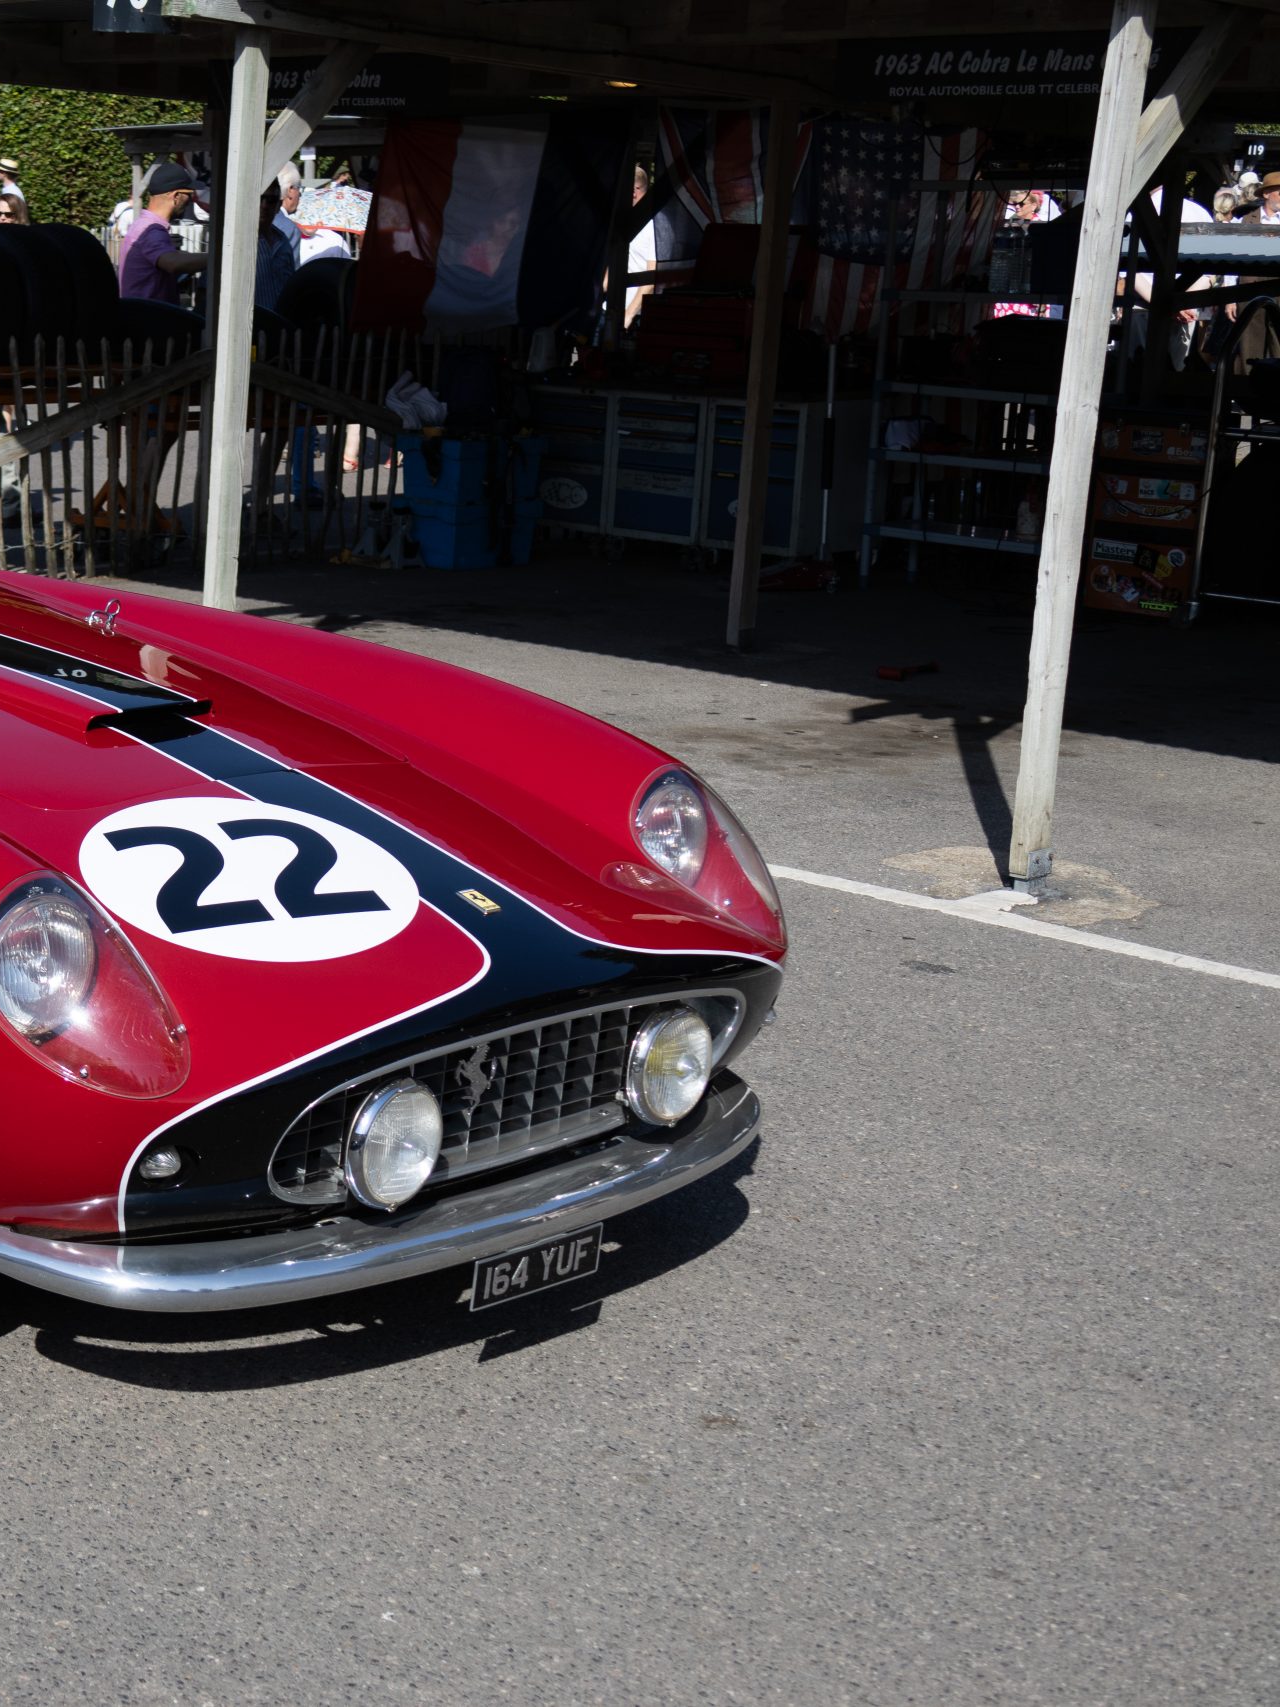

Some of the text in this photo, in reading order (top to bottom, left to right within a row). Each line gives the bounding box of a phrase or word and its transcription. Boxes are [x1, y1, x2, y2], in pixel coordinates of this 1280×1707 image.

[874, 53, 922, 76] 1963
[924, 51, 954, 76] AC
[958, 49, 1010, 74] Cobra
[1016, 49, 1038, 73] Le
[1043, 48, 1095, 72] Mans
[347, 67, 382, 89] obra
[888, 83, 1100, 97] ROYAL AUTOMOBILE CLUB TT CELEBR
[340, 97, 351, 107] TT
[352, 97, 407, 107] CELEBRATION
[1248, 144, 1265, 156] 119
[103, 818, 391, 934] 22
[483, 1235, 593, 1300] 164 YUF
